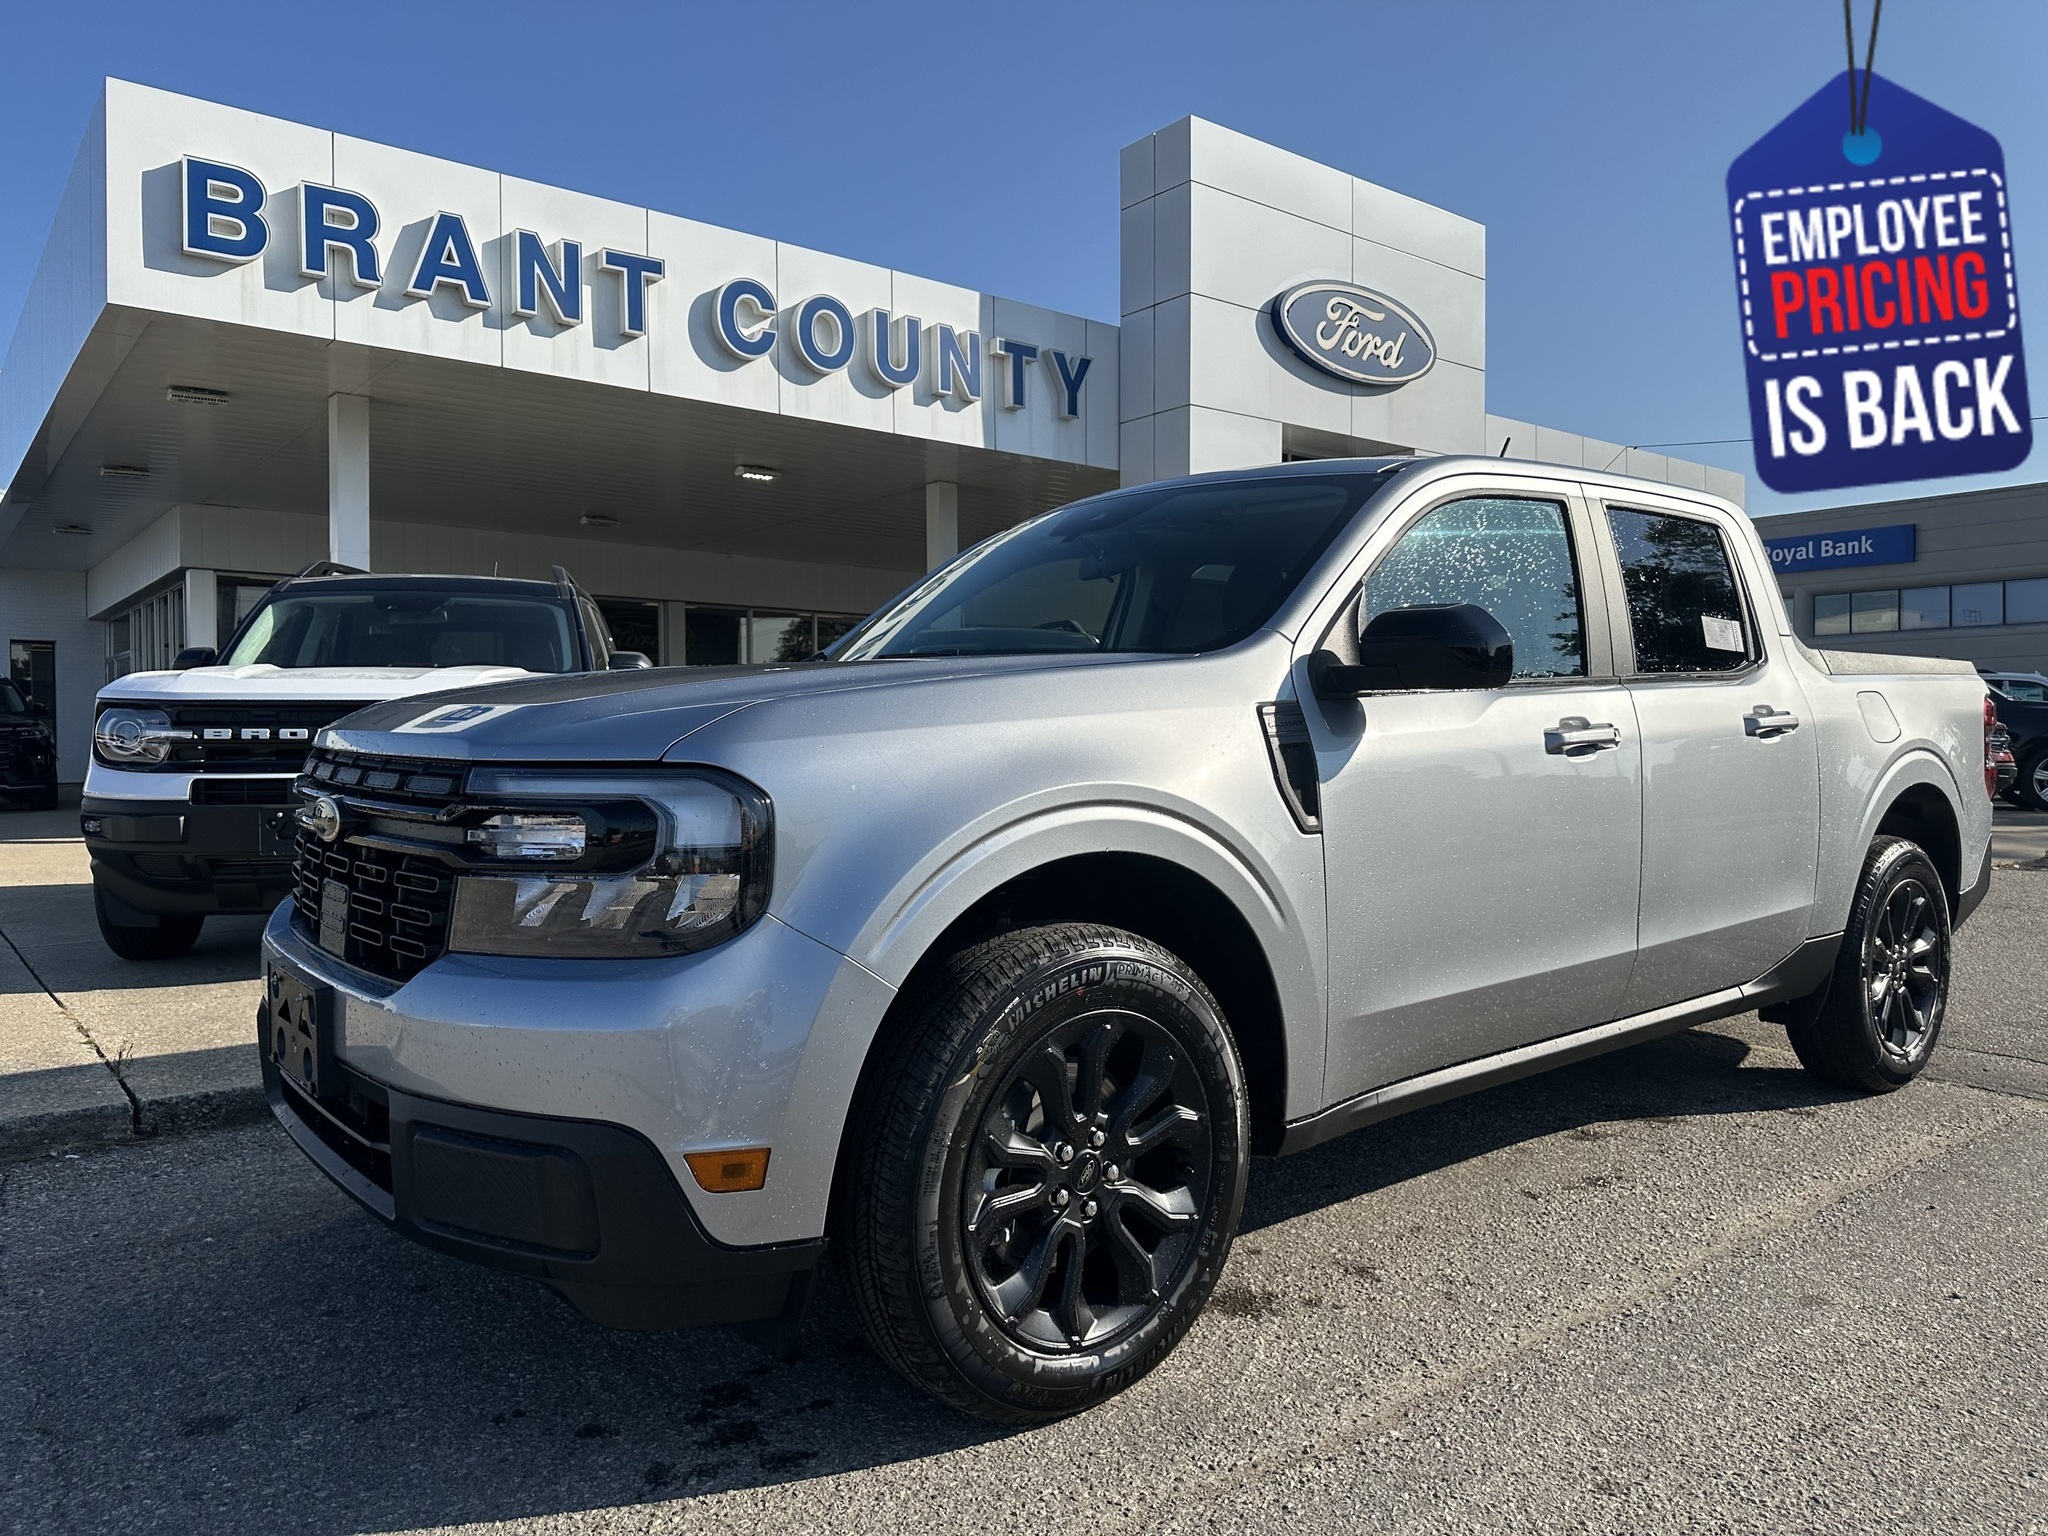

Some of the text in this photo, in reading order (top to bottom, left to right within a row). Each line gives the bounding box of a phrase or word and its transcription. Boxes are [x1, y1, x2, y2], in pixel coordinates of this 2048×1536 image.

[182, 154, 1094, 421] BRANT COUNTY
[1316, 296, 1407, 370] Ford
[1820, 535, 1874, 558] Bank
[1007, 966, 1103, 1033] MICHELIN
